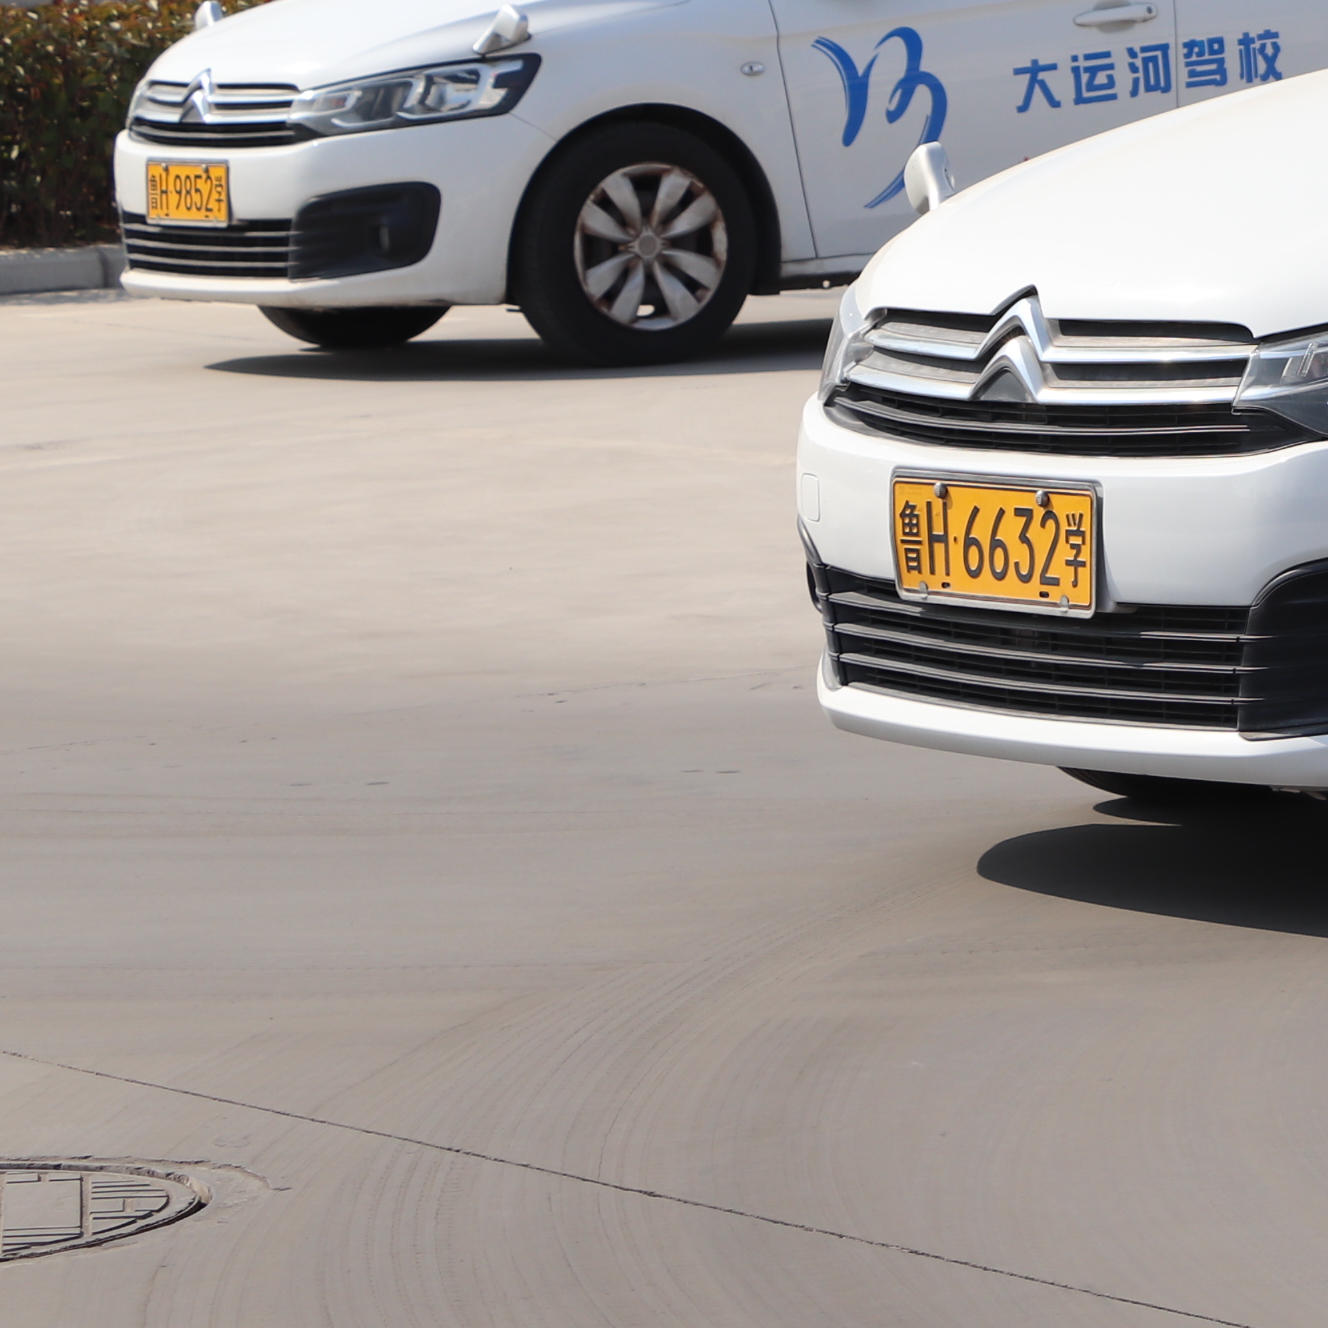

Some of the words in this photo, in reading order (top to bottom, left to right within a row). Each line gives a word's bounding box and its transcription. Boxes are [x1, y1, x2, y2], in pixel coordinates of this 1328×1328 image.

[1012, 29, 1283, 113] 大运河驾校
